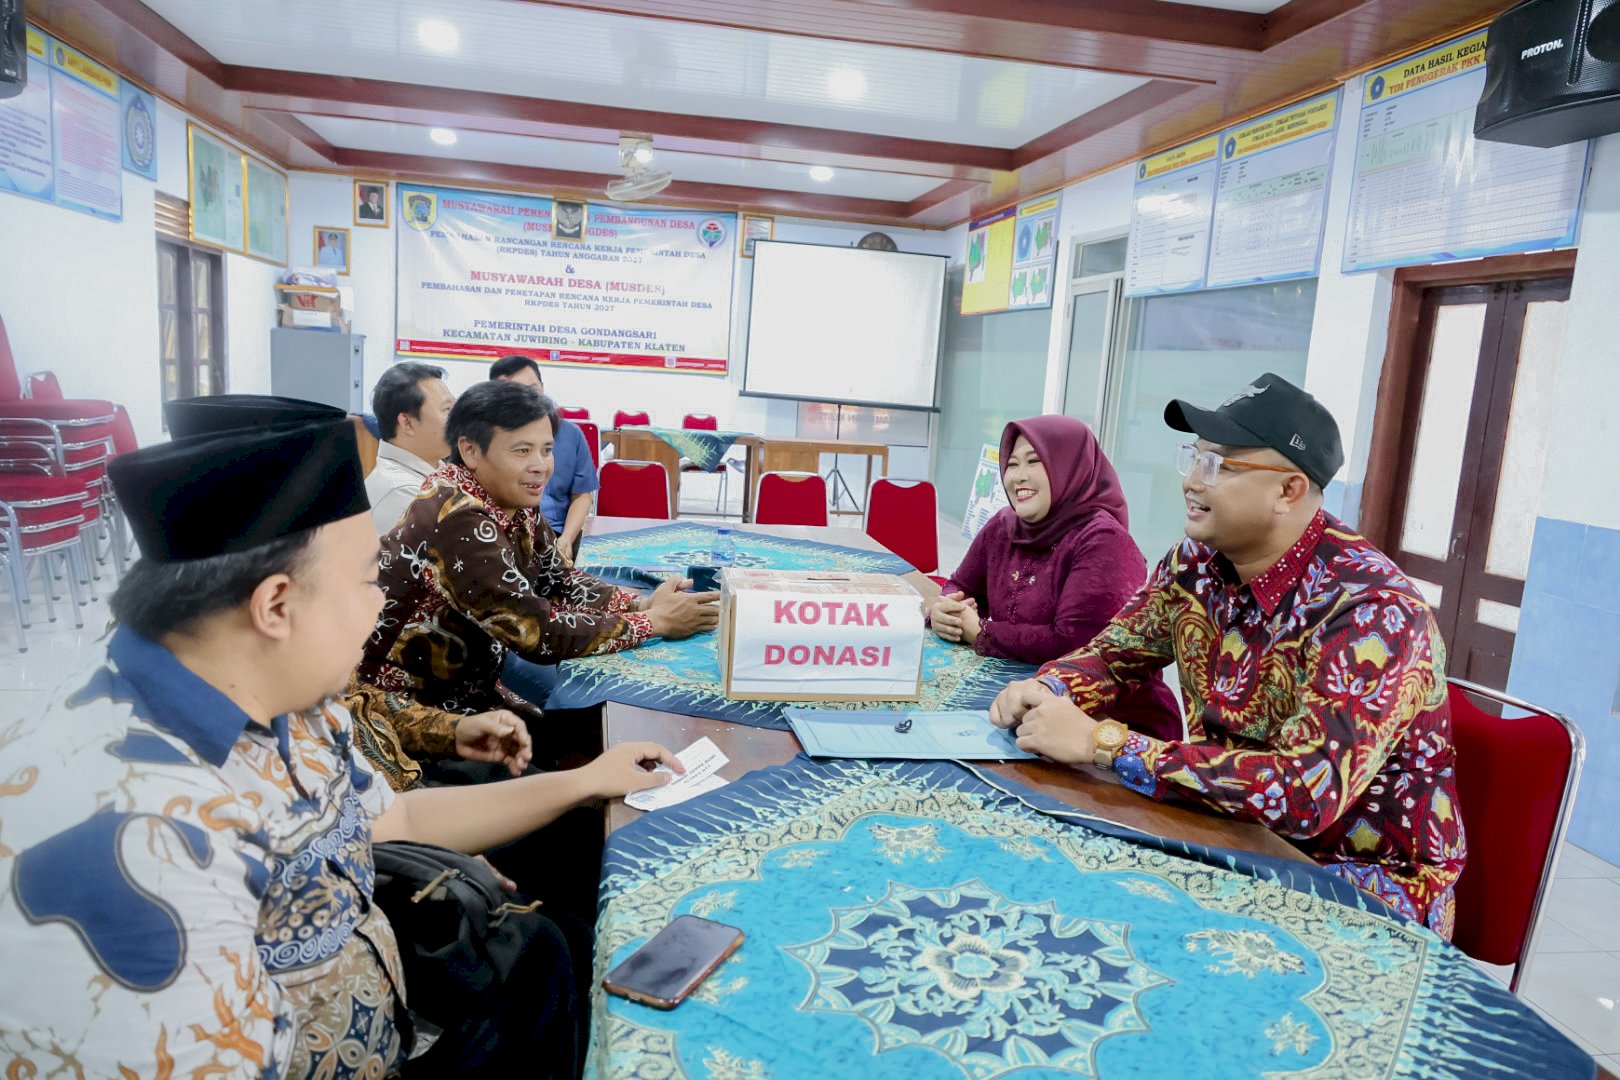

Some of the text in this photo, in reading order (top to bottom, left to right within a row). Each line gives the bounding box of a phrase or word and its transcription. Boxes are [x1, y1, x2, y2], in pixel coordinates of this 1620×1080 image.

[1403, 63, 1425, 78] DATA
[1427, 53, 1454, 70] HASIL
[1456, 40, 1488, 59] KEGIA
[1389, 82, 1404, 95] TIM
[1405, 62, 1459, 89] PENGGERAK
[1460, 54, 1481, 70] PKK
[594, 214, 667, 229] PEMBANGUNAN
[669, 219, 695, 230] DESA
[494, 235, 548, 248] RANCANGAN
[550, 241, 592, 252] RENCANA
[594, 244, 623, 254] KERJA
[541, 249, 570, 259] TAHUN
[572, 252, 620, 263] ANGGARAN
[565, 264, 575, 275] &
[470, 270, 666, 297] MUSYAWARAH DESA (MUSDES)
[421, 281, 713, 310] PEMBAHASAN DAN PENETAPAN RENCANA KERJA PEMERINTAH DESA
[562, 302, 592, 311] TAHUN
[443, 329, 512, 342] KECAMATAN
[514, 334, 568, 346] JUWIRING
[578, 338, 641, 351] KABUPATEN
[644, 343, 686, 353] KLATEN
[473, 319, 657, 340] PEMERINTAH DESA GONDANGSARI
[773, 600, 890, 627] KOTAK
[763, 644, 891, 667] DONASI
